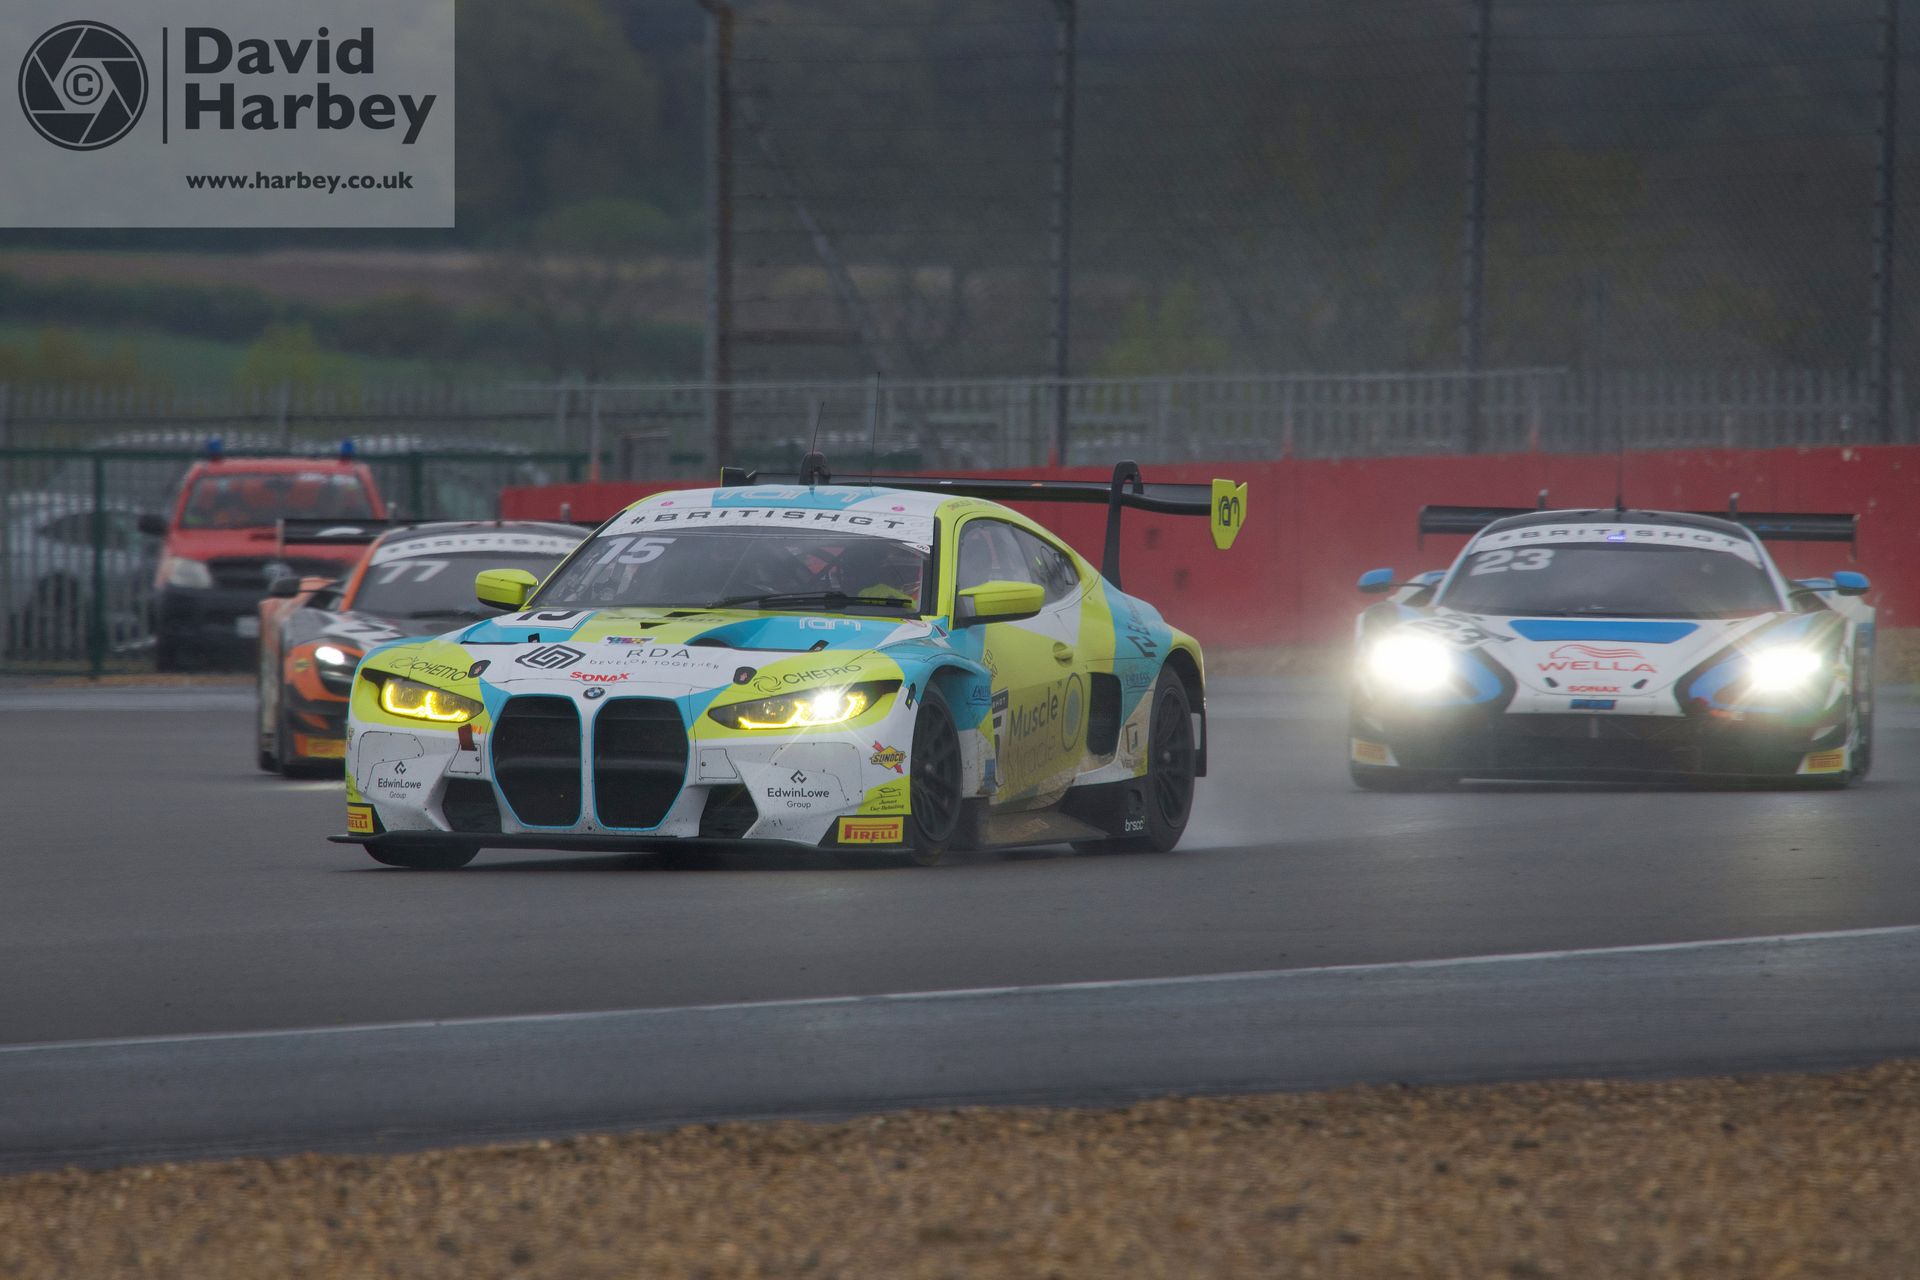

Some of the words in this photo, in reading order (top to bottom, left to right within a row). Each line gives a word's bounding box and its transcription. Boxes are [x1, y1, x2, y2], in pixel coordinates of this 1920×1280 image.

[630, 509, 905, 529] #BRITISHGT
[596, 537, 678, 564] 15
[1469, 547, 1556, 576] 23
[377, 560, 450, 584] 77
[626, 647, 691, 659] RDA
[589, 658, 648, 666] DEVELOP
[654, 660, 720, 670] TOGETHER
[1536, 660, 1657, 673] WELLA
[411, 661, 468, 681] CHEMO
[570, 671, 630, 682] SONAX
[783, 664, 862, 685] CHEMO
[1567, 685, 1621, 693] SONAX
[1007, 687, 1059, 747] Muscle
[872, 752, 905, 763] SUNOCO
[377, 778, 421, 789] EdwinLowe
[389, 791, 407, 799] Group
[767, 787, 830, 798] EdwinLowe
[786, 800, 812, 809] Group
[844, 823, 898, 840] PIRELLI
